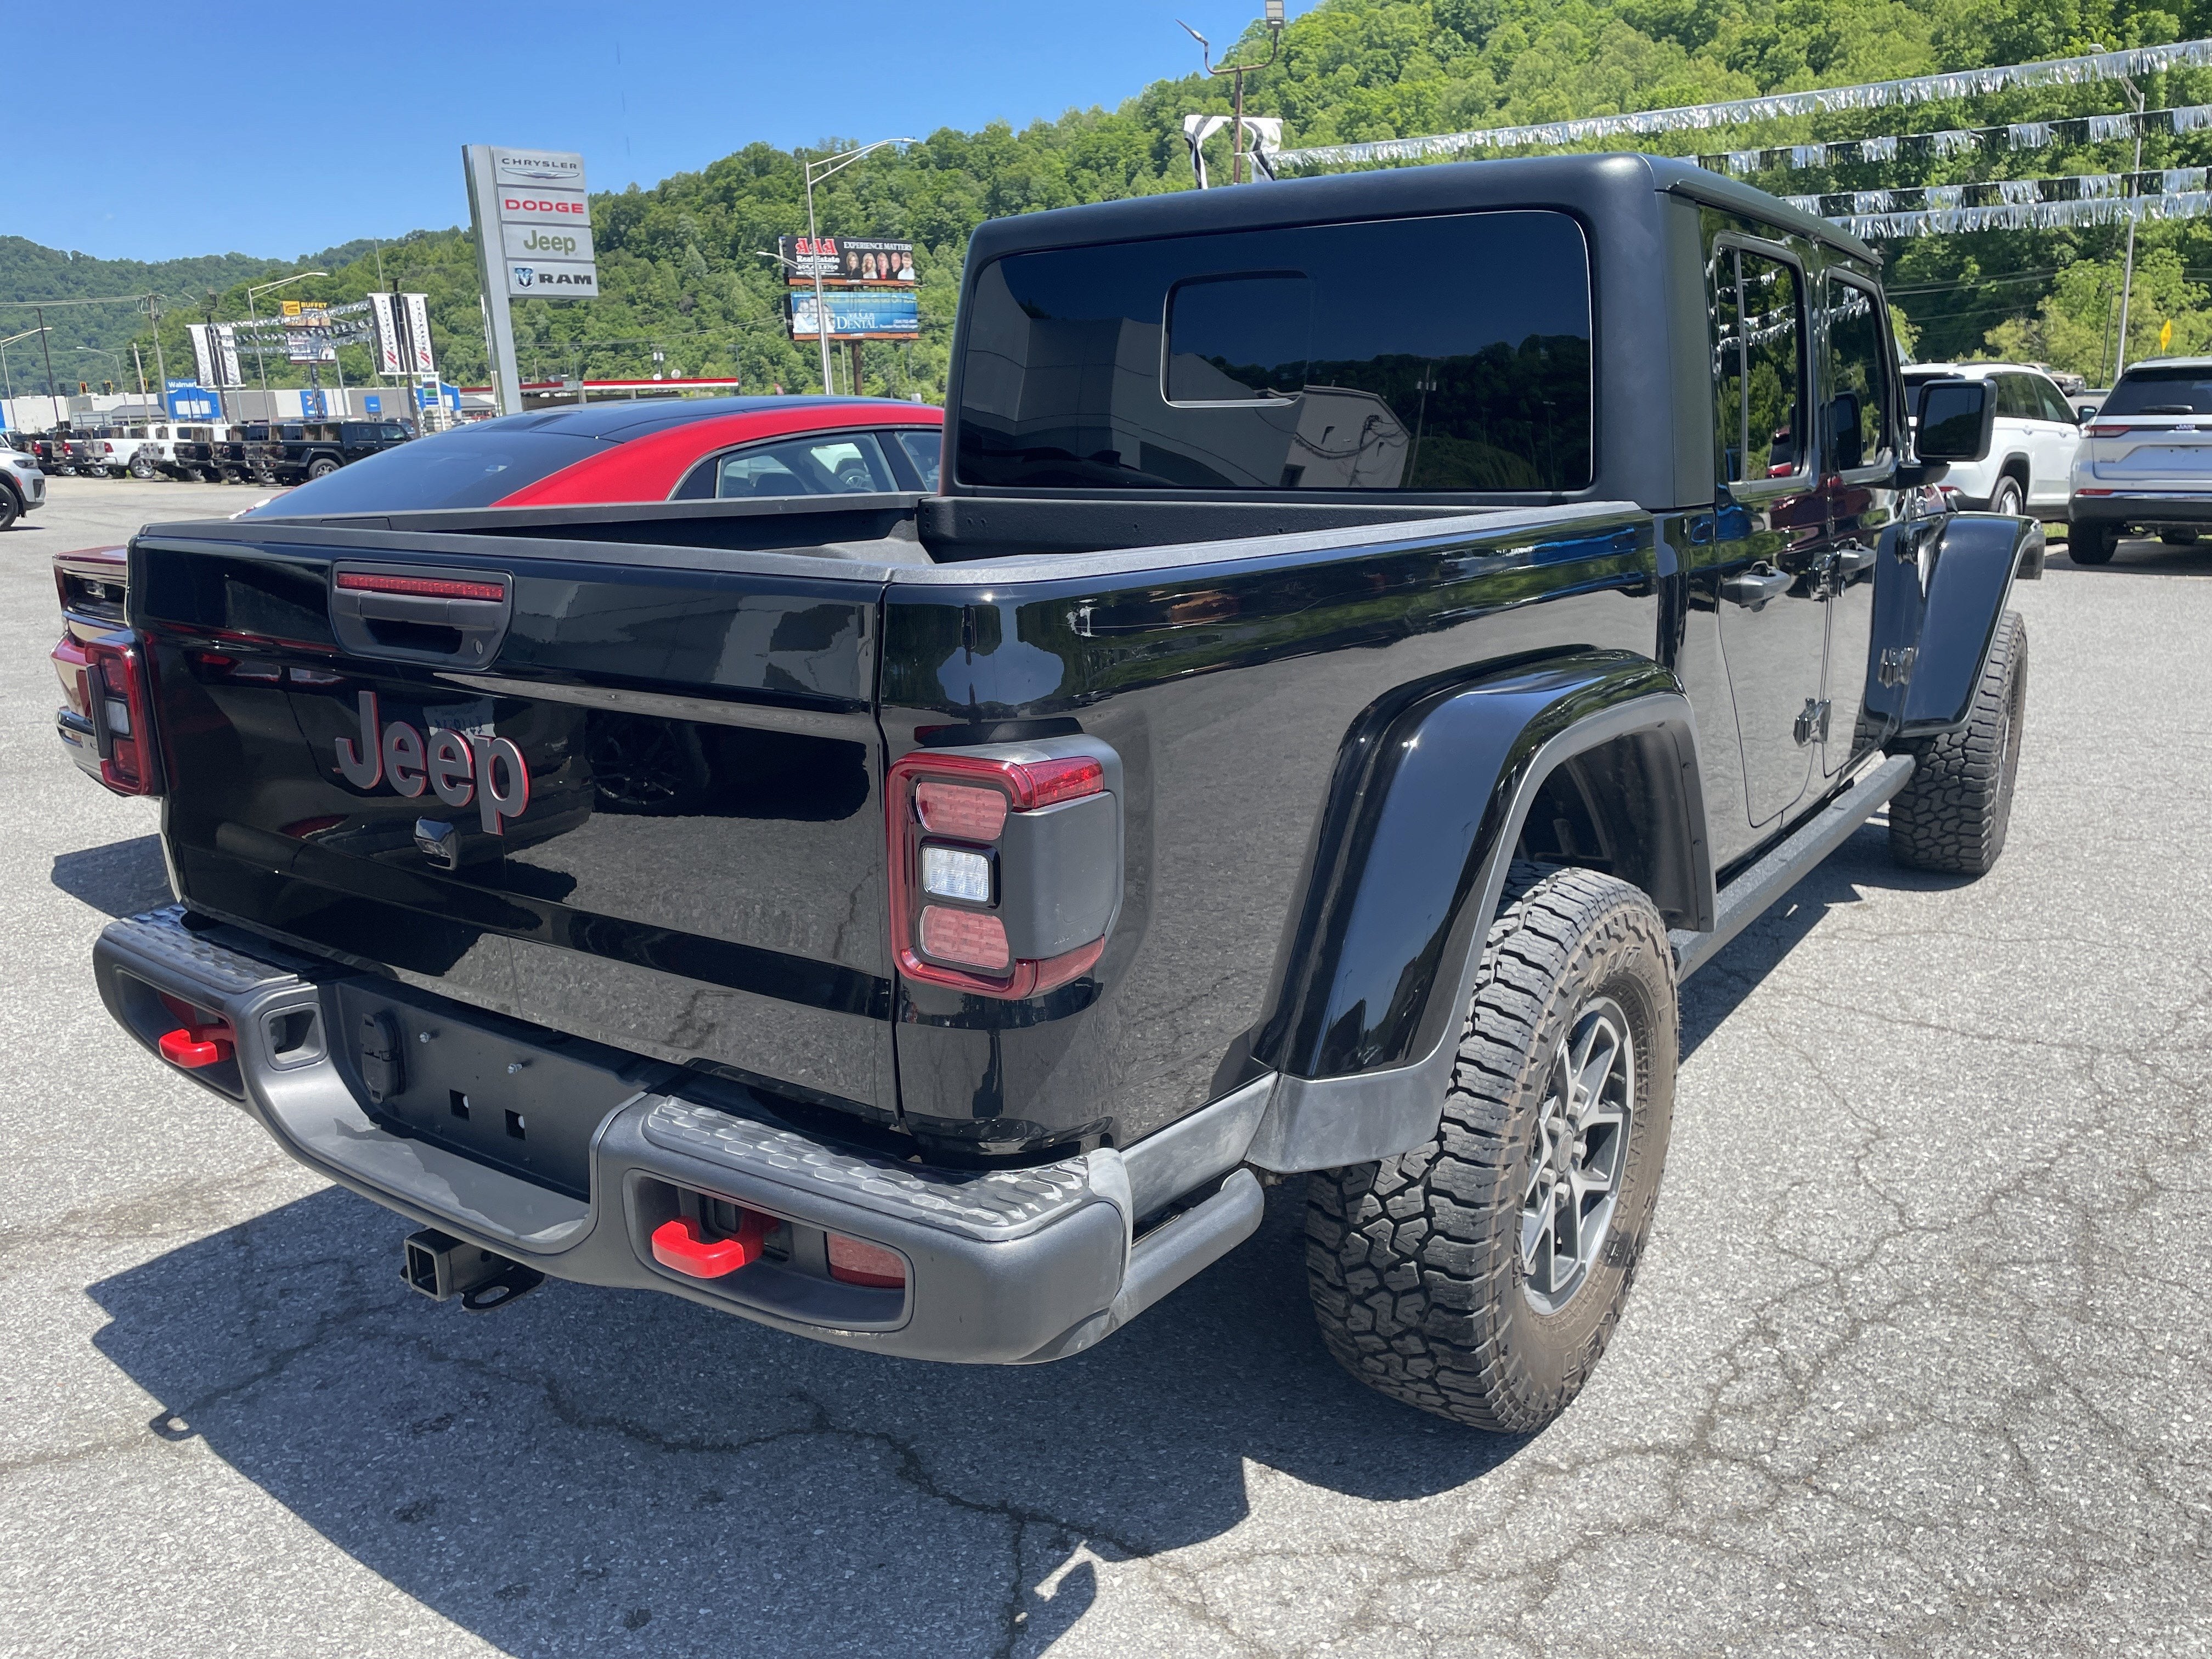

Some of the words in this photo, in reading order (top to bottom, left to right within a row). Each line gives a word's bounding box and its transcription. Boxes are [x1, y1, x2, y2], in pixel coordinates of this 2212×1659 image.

[501, 157, 577, 170] CHRYSLER
[505, 199, 584, 214] DODGE
[523, 229, 576, 256] Jeep
[795, 238, 838, 255] AAA
[884, 242, 912, 251] MATTERS
[539, 273, 592, 285] RAM
[335, 690, 530, 836] Jeep
